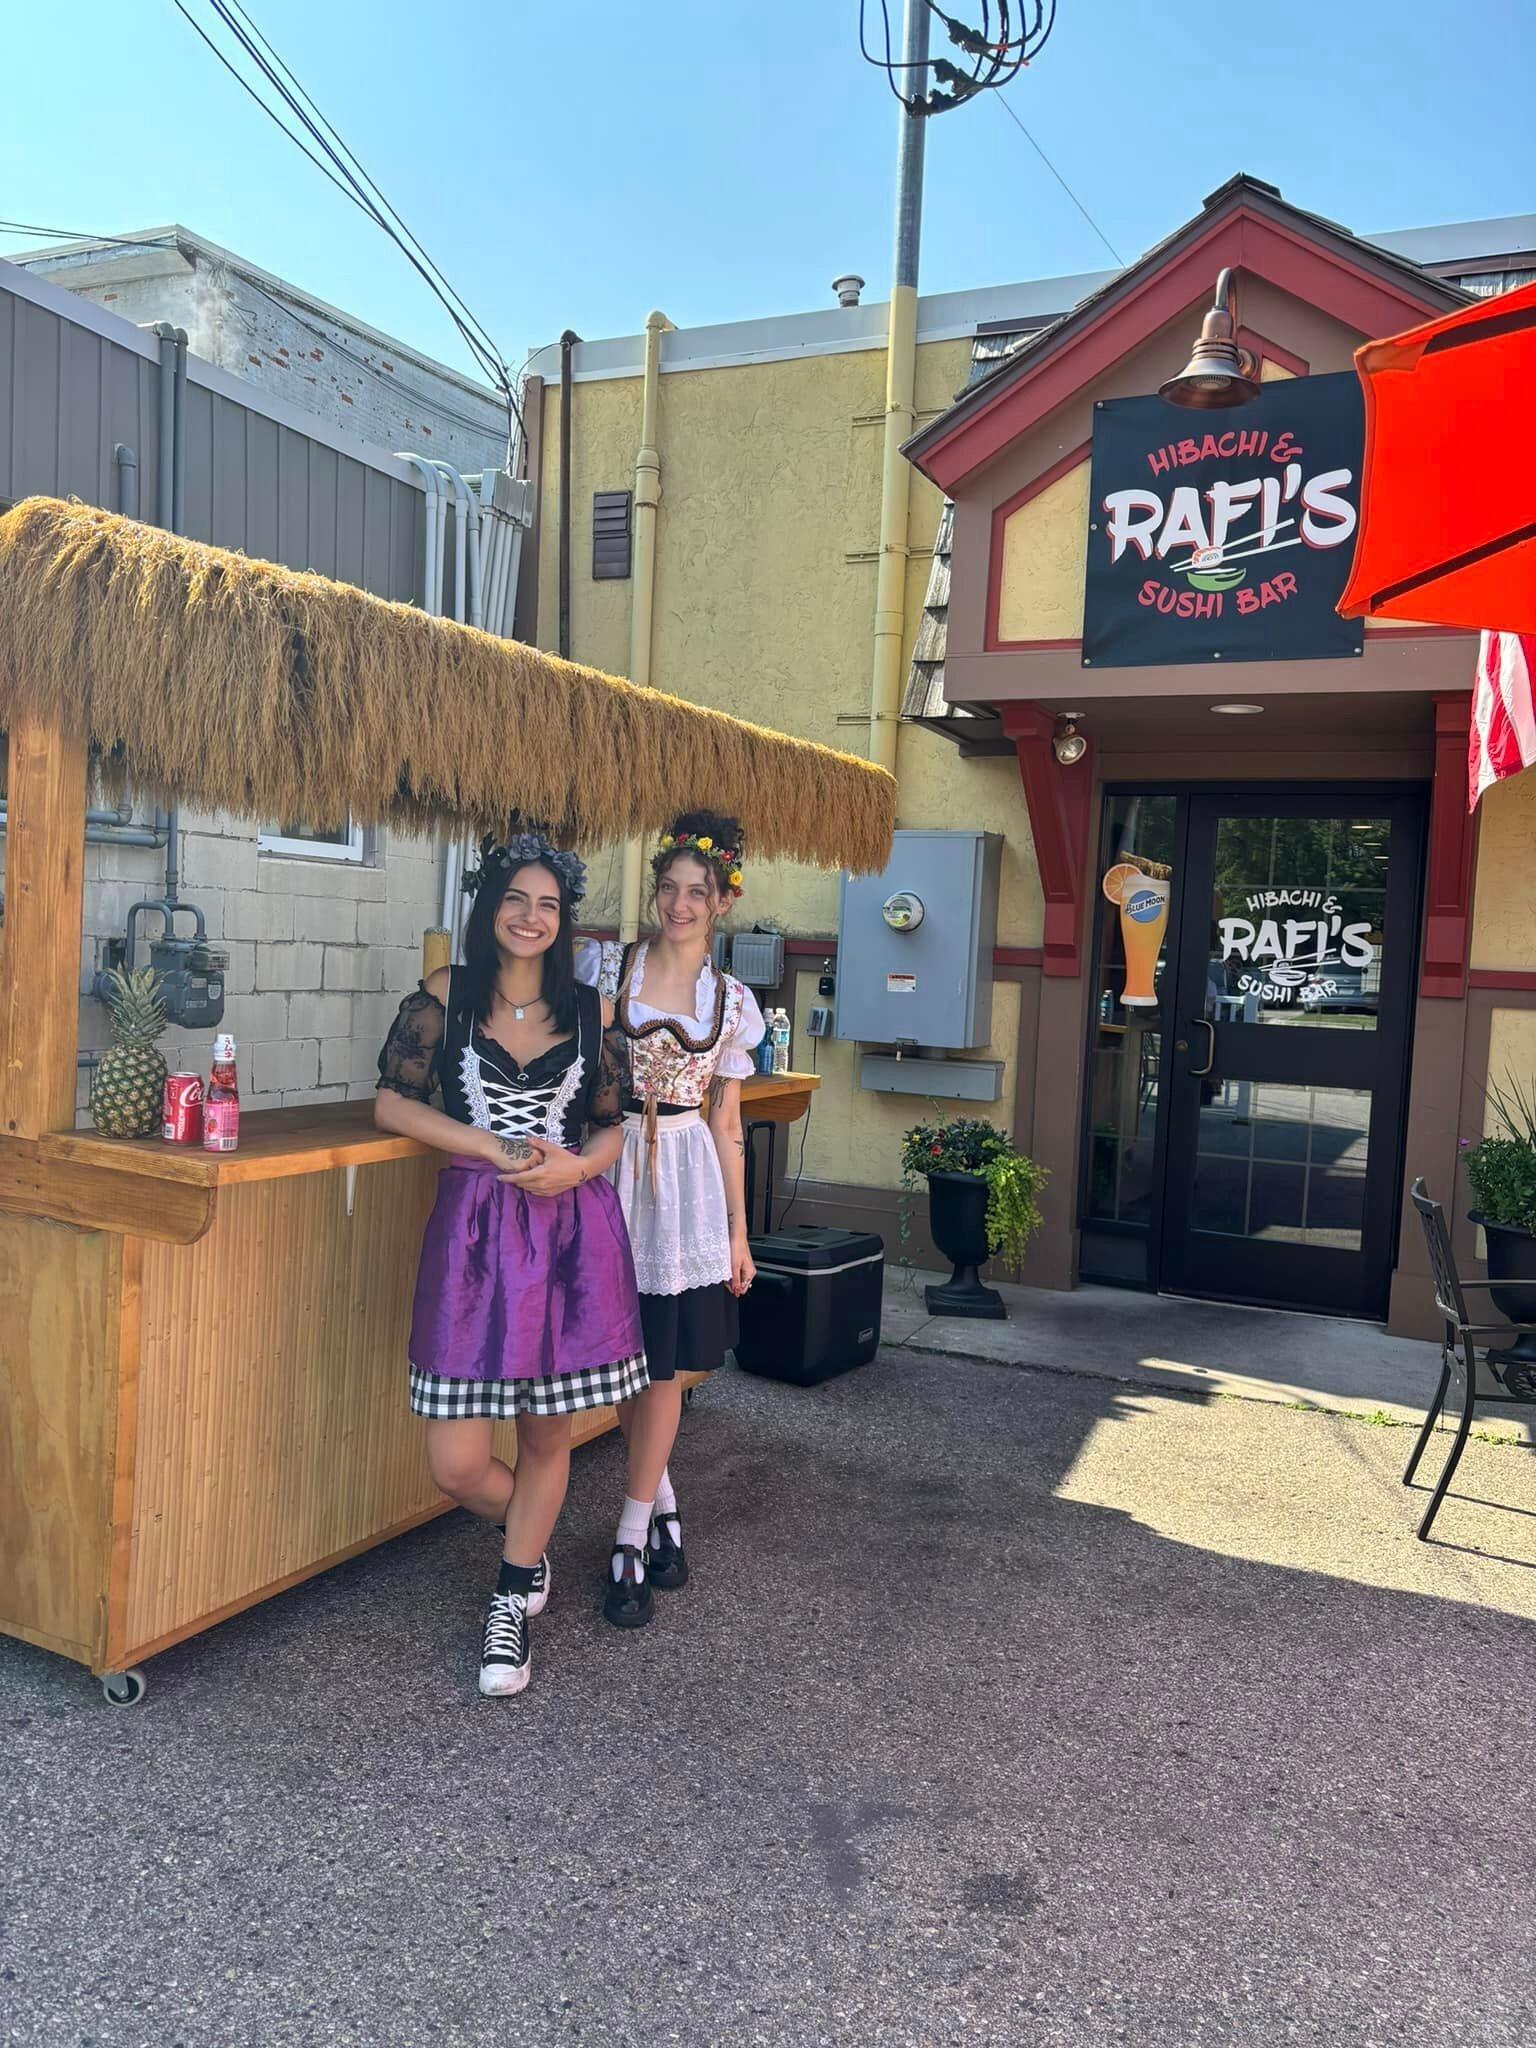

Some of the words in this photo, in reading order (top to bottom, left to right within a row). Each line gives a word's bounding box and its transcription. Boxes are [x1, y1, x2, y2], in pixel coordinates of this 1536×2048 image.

[1148, 431, 1267, 478] HIBACHI
[1270, 432, 1303, 463] &
[1104, 463, 1357, 564] RAFI'S
[1138, 581, 1223, 619] SUSHI
[1236, 571, 1298, 615] BAR
[1126, 902, 1144, 914] BLUE
[1146, 896, 1164, 908] MOON
[1246, 890, 1321, 912] HIBACHI
[1323, 896, 1343, 914] &
[1219, 915, 1373, 967] RAFI'S
[1237, 975, 1292, 1002] SUSHI
[1299, 980, 1338, 1002] BAR
